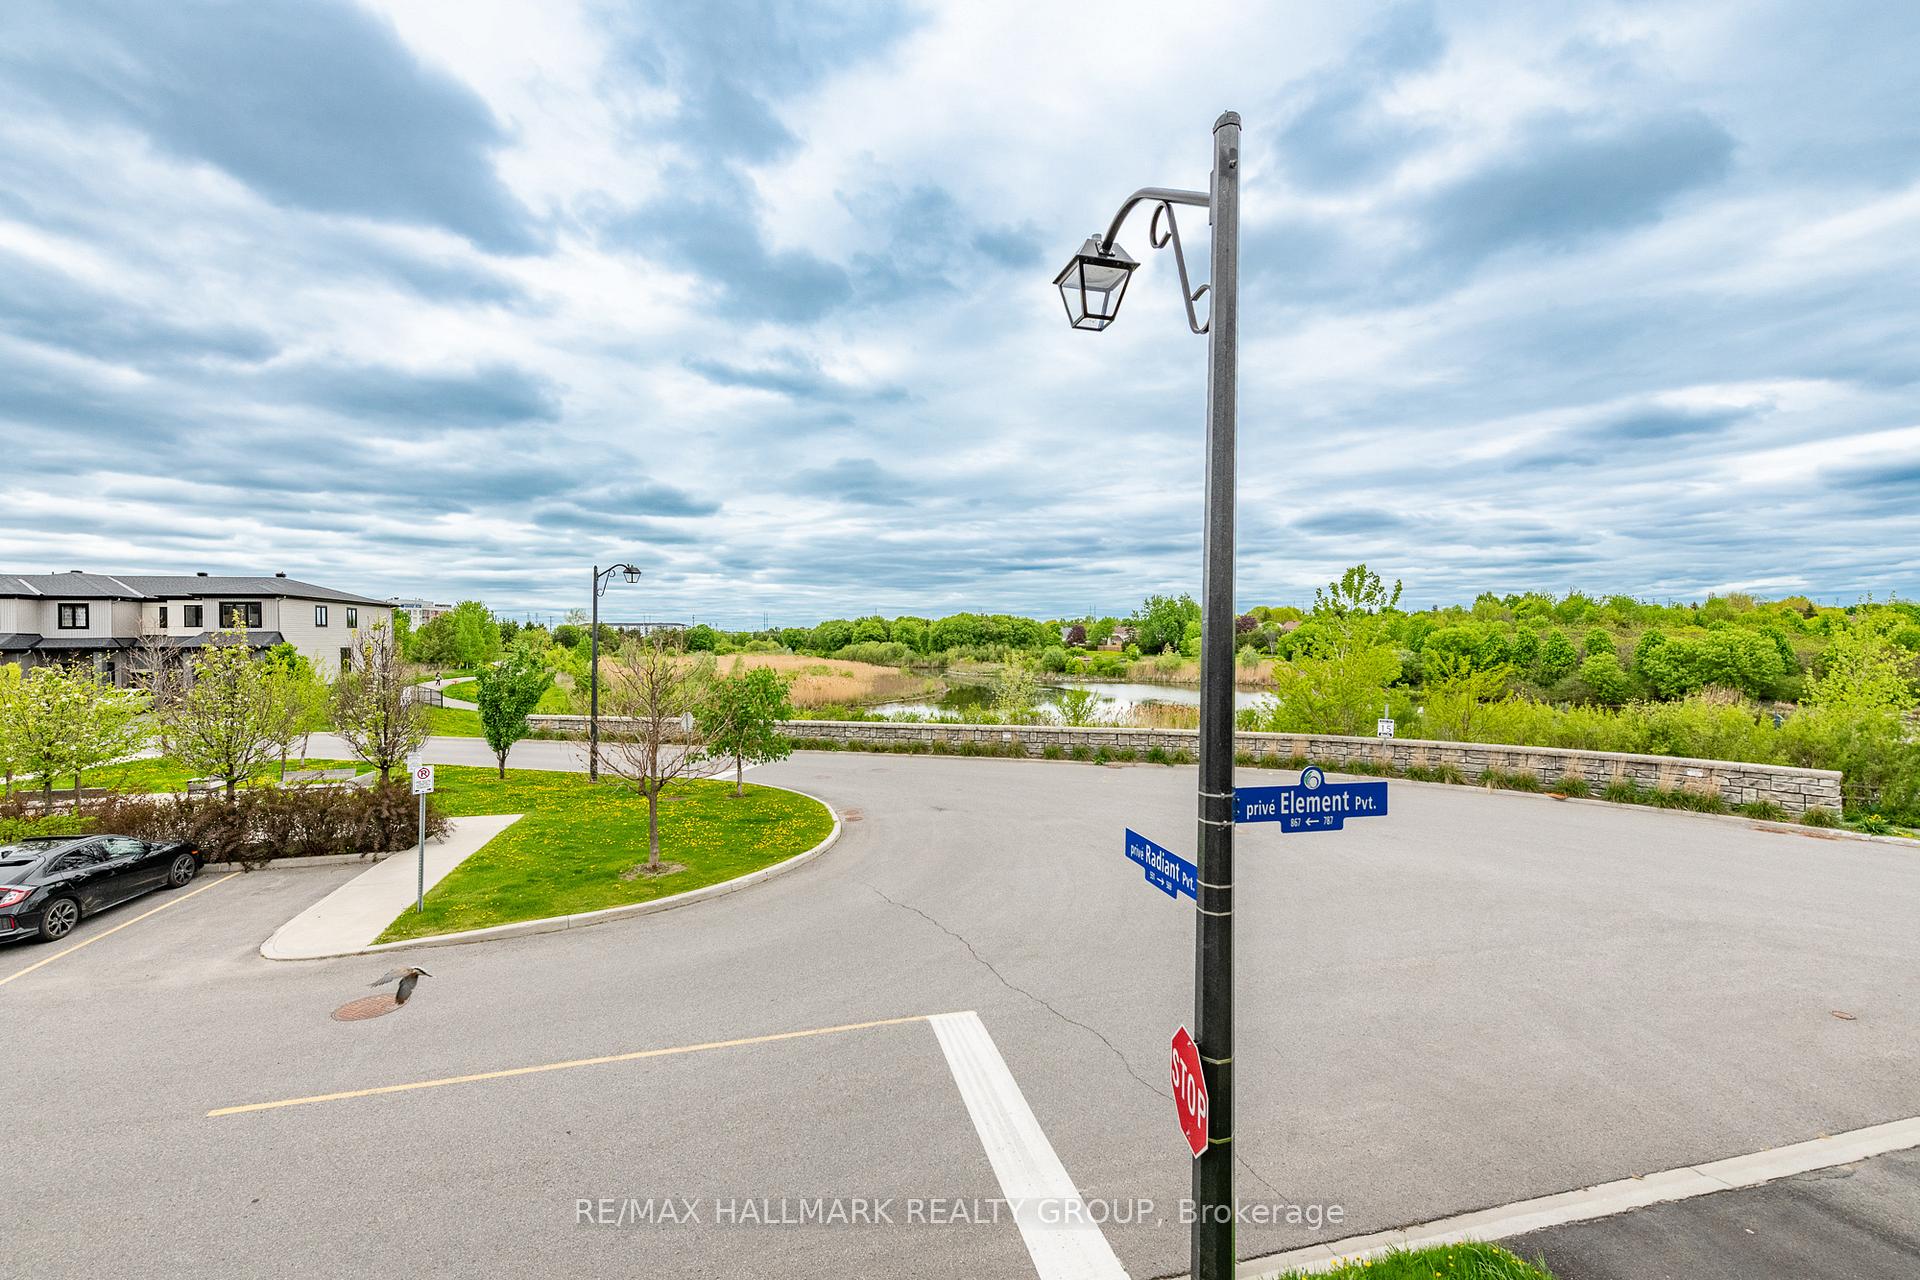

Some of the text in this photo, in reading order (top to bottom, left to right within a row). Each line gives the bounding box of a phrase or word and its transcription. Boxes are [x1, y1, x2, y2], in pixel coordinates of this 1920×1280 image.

[1246, 790, 1377, 820] privé Element Pvt.
[1130, 844, 1144, 860] privé
[1145, 844, 1180, 882] Radiant
[1182, 872, 1195, 892] Pvt.
[1172, 1047, 1206, 1129] STOP
